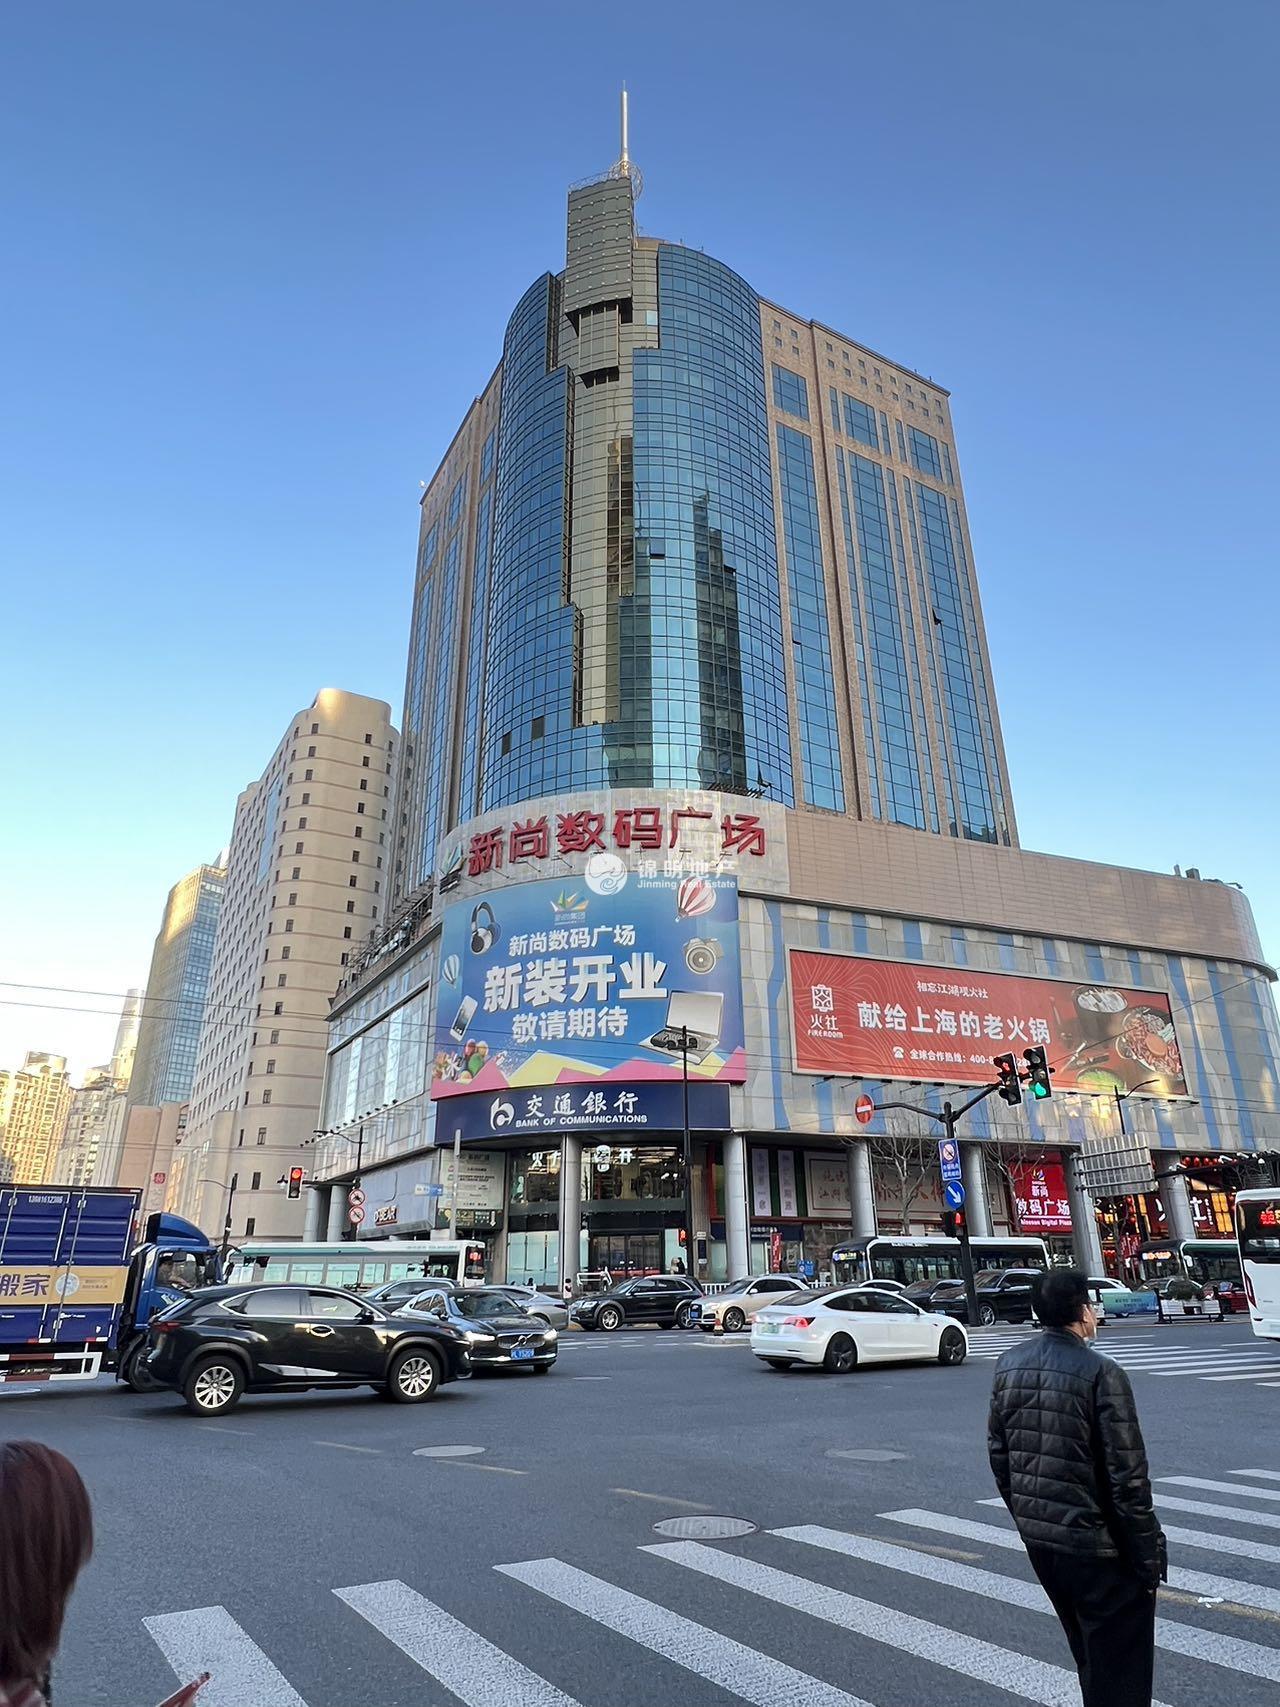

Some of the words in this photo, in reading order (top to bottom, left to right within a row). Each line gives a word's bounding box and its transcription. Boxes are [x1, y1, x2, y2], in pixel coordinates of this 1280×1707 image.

[467, 806, 766, 876] 新尚数码广场
[508, 925, 636, 957] 新尚数码广场
[482, 952, 668, 1013] 新装开业
[511, 1005, 629, 1044] 敬请期待
[810, 1013, 839, 1031] 火社
[857, 1001, 1051, 1044] 献给上海的老火锅
[515, 1118, 539, 1128] BANK
[543, 1117, 556, 1126] OF
[560, 1114, 648, 1125] COMMUNICATIONS
[525, 1091, 639, 1117] 交通銀行
